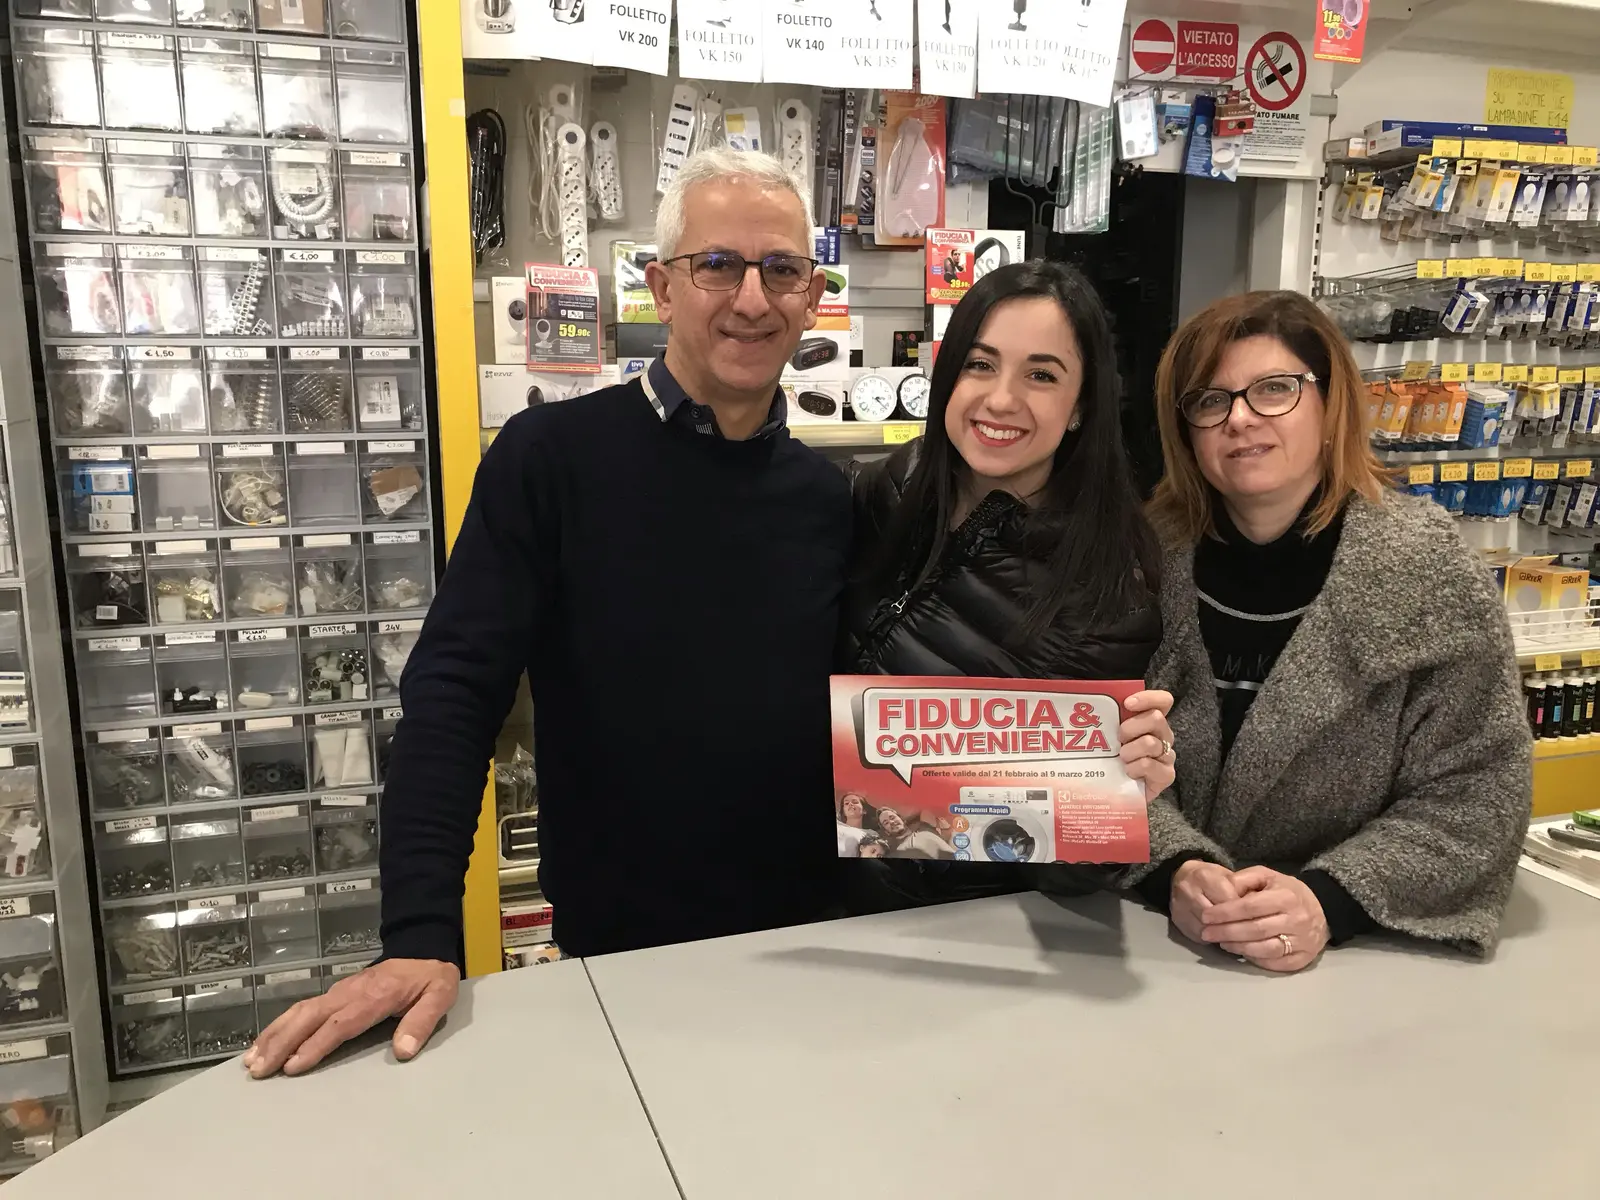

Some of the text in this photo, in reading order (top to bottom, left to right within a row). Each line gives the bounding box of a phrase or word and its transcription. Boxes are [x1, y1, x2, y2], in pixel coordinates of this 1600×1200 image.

[609, 3, 667, 25] FOLLETTO
[777, 13, 833, 28] FOLLETTO
[619, 30, 658, 48] VK 200
[685, 29, 754, 46] FOLLETTO
[786, 37, 825, 51] VK 140
[841, 36, 910, 51] FOLLETTO
[1183, 30, 1234, 46] VIETATO
[700, 48, 742, 64] VK 150
[924, 41, 975, 58] FOLLETTO
[854, 54, 897, 68] VK 135
[935, 59, 967, 74] VK 130
[1003, 54, 1020, 67] VK
[1178, 52, 1236, 69] L'ACCESSO
[1061, 62, 1077, 76] VK
[1493, 91, 1505, 105] SU
[1271, 112, 1300, 120] FUMARE
[1487, 109, 1569, 128] LAMPADINE E14
[935, 231, 963, 239] FIDUCIA
[534, 268, 581, 281] FIDUCIA
[533, 277, 593, 287] CONVENIENZA
[639, 303, 657, 313] DRU
[486, 411, 508, 423] Husky
[311, 626, 346, 634] STARTER
[877, 697, 1102, 731] FIDUCIA &
[875, 729, 1112, 758] CONVENIENZA
[922, 768, 1106, 779] Offerte valide dal 21 febbraio al 9 marzo 2019
[954, 806, 1009, 815] Programmi Rapidi
